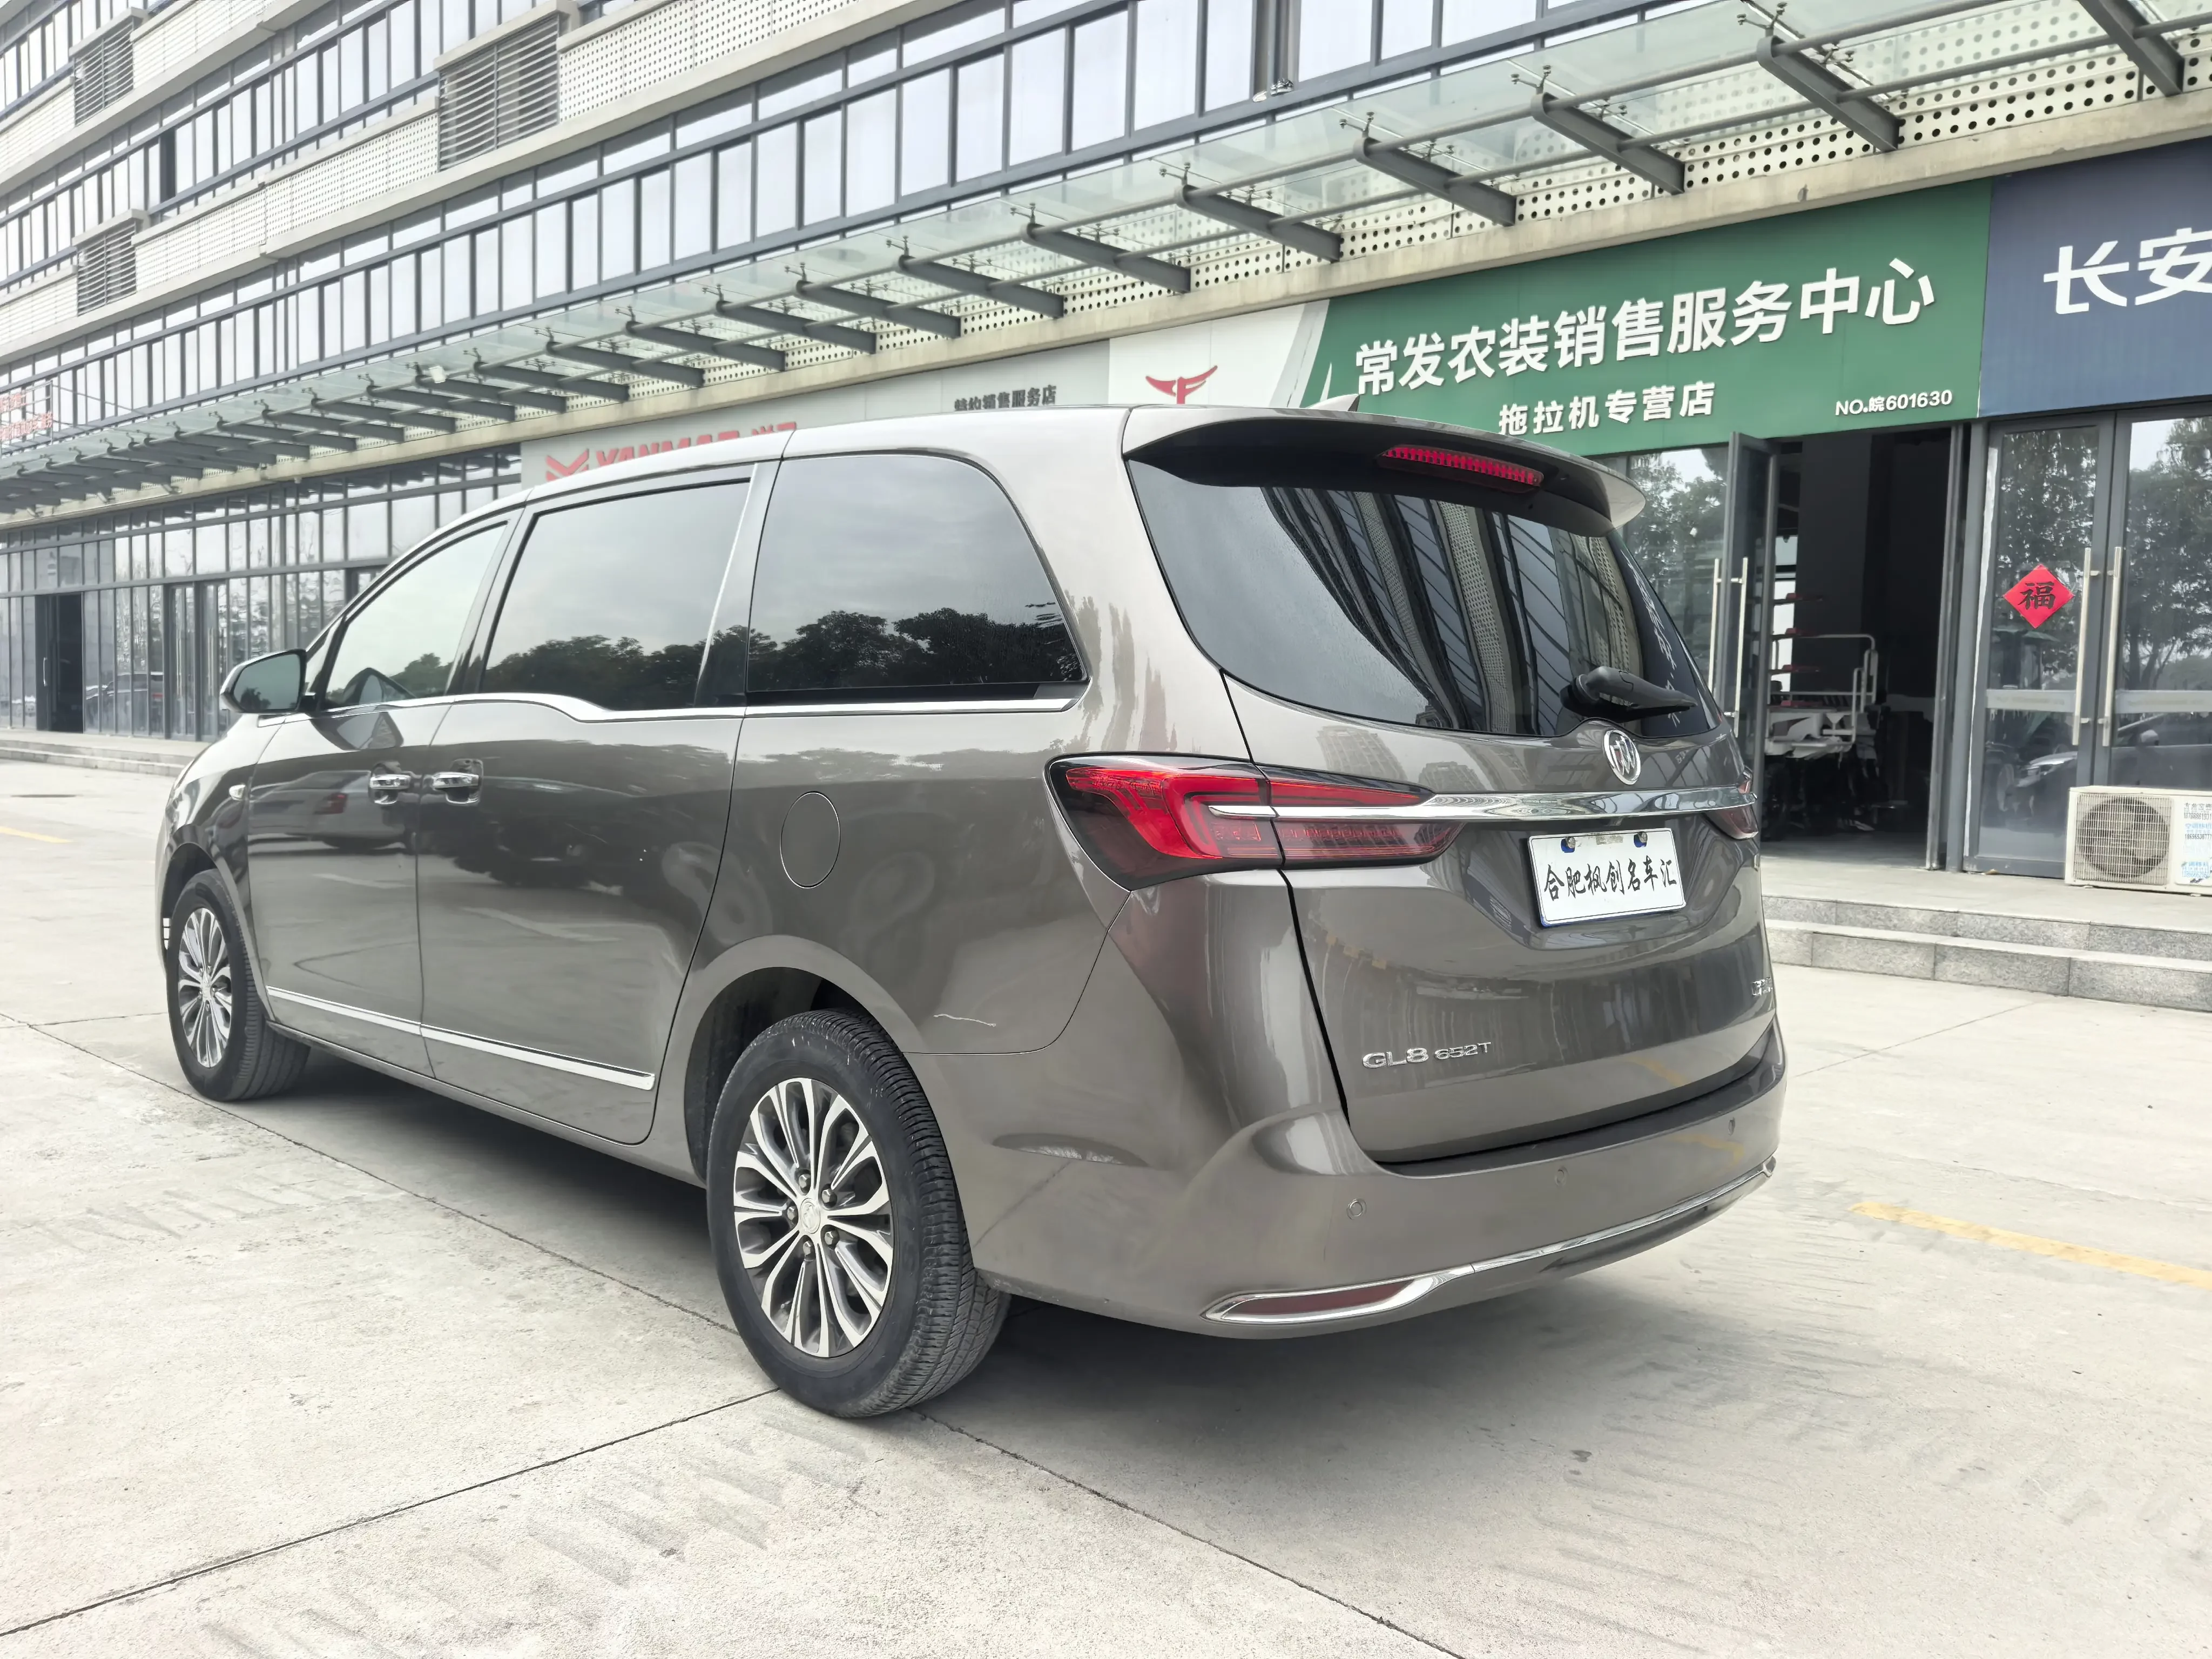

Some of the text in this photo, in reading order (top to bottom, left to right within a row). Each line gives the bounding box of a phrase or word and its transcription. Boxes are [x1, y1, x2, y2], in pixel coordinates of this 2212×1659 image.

[2043, 227, 2212, 314] 长安
[1355, 258, 1934, 395] 常发农装销售服务中心
[1498, 380, 1715, 436] 拖拉机专营店
[1835, 389, 1953, 416] NO.皖601630
[2018, 581, 2056, 611] 福
[1544, 855, 1677, 901] 合肥枫创名车汇
[1363, 1042, 1492, 1068] GL8 652T
